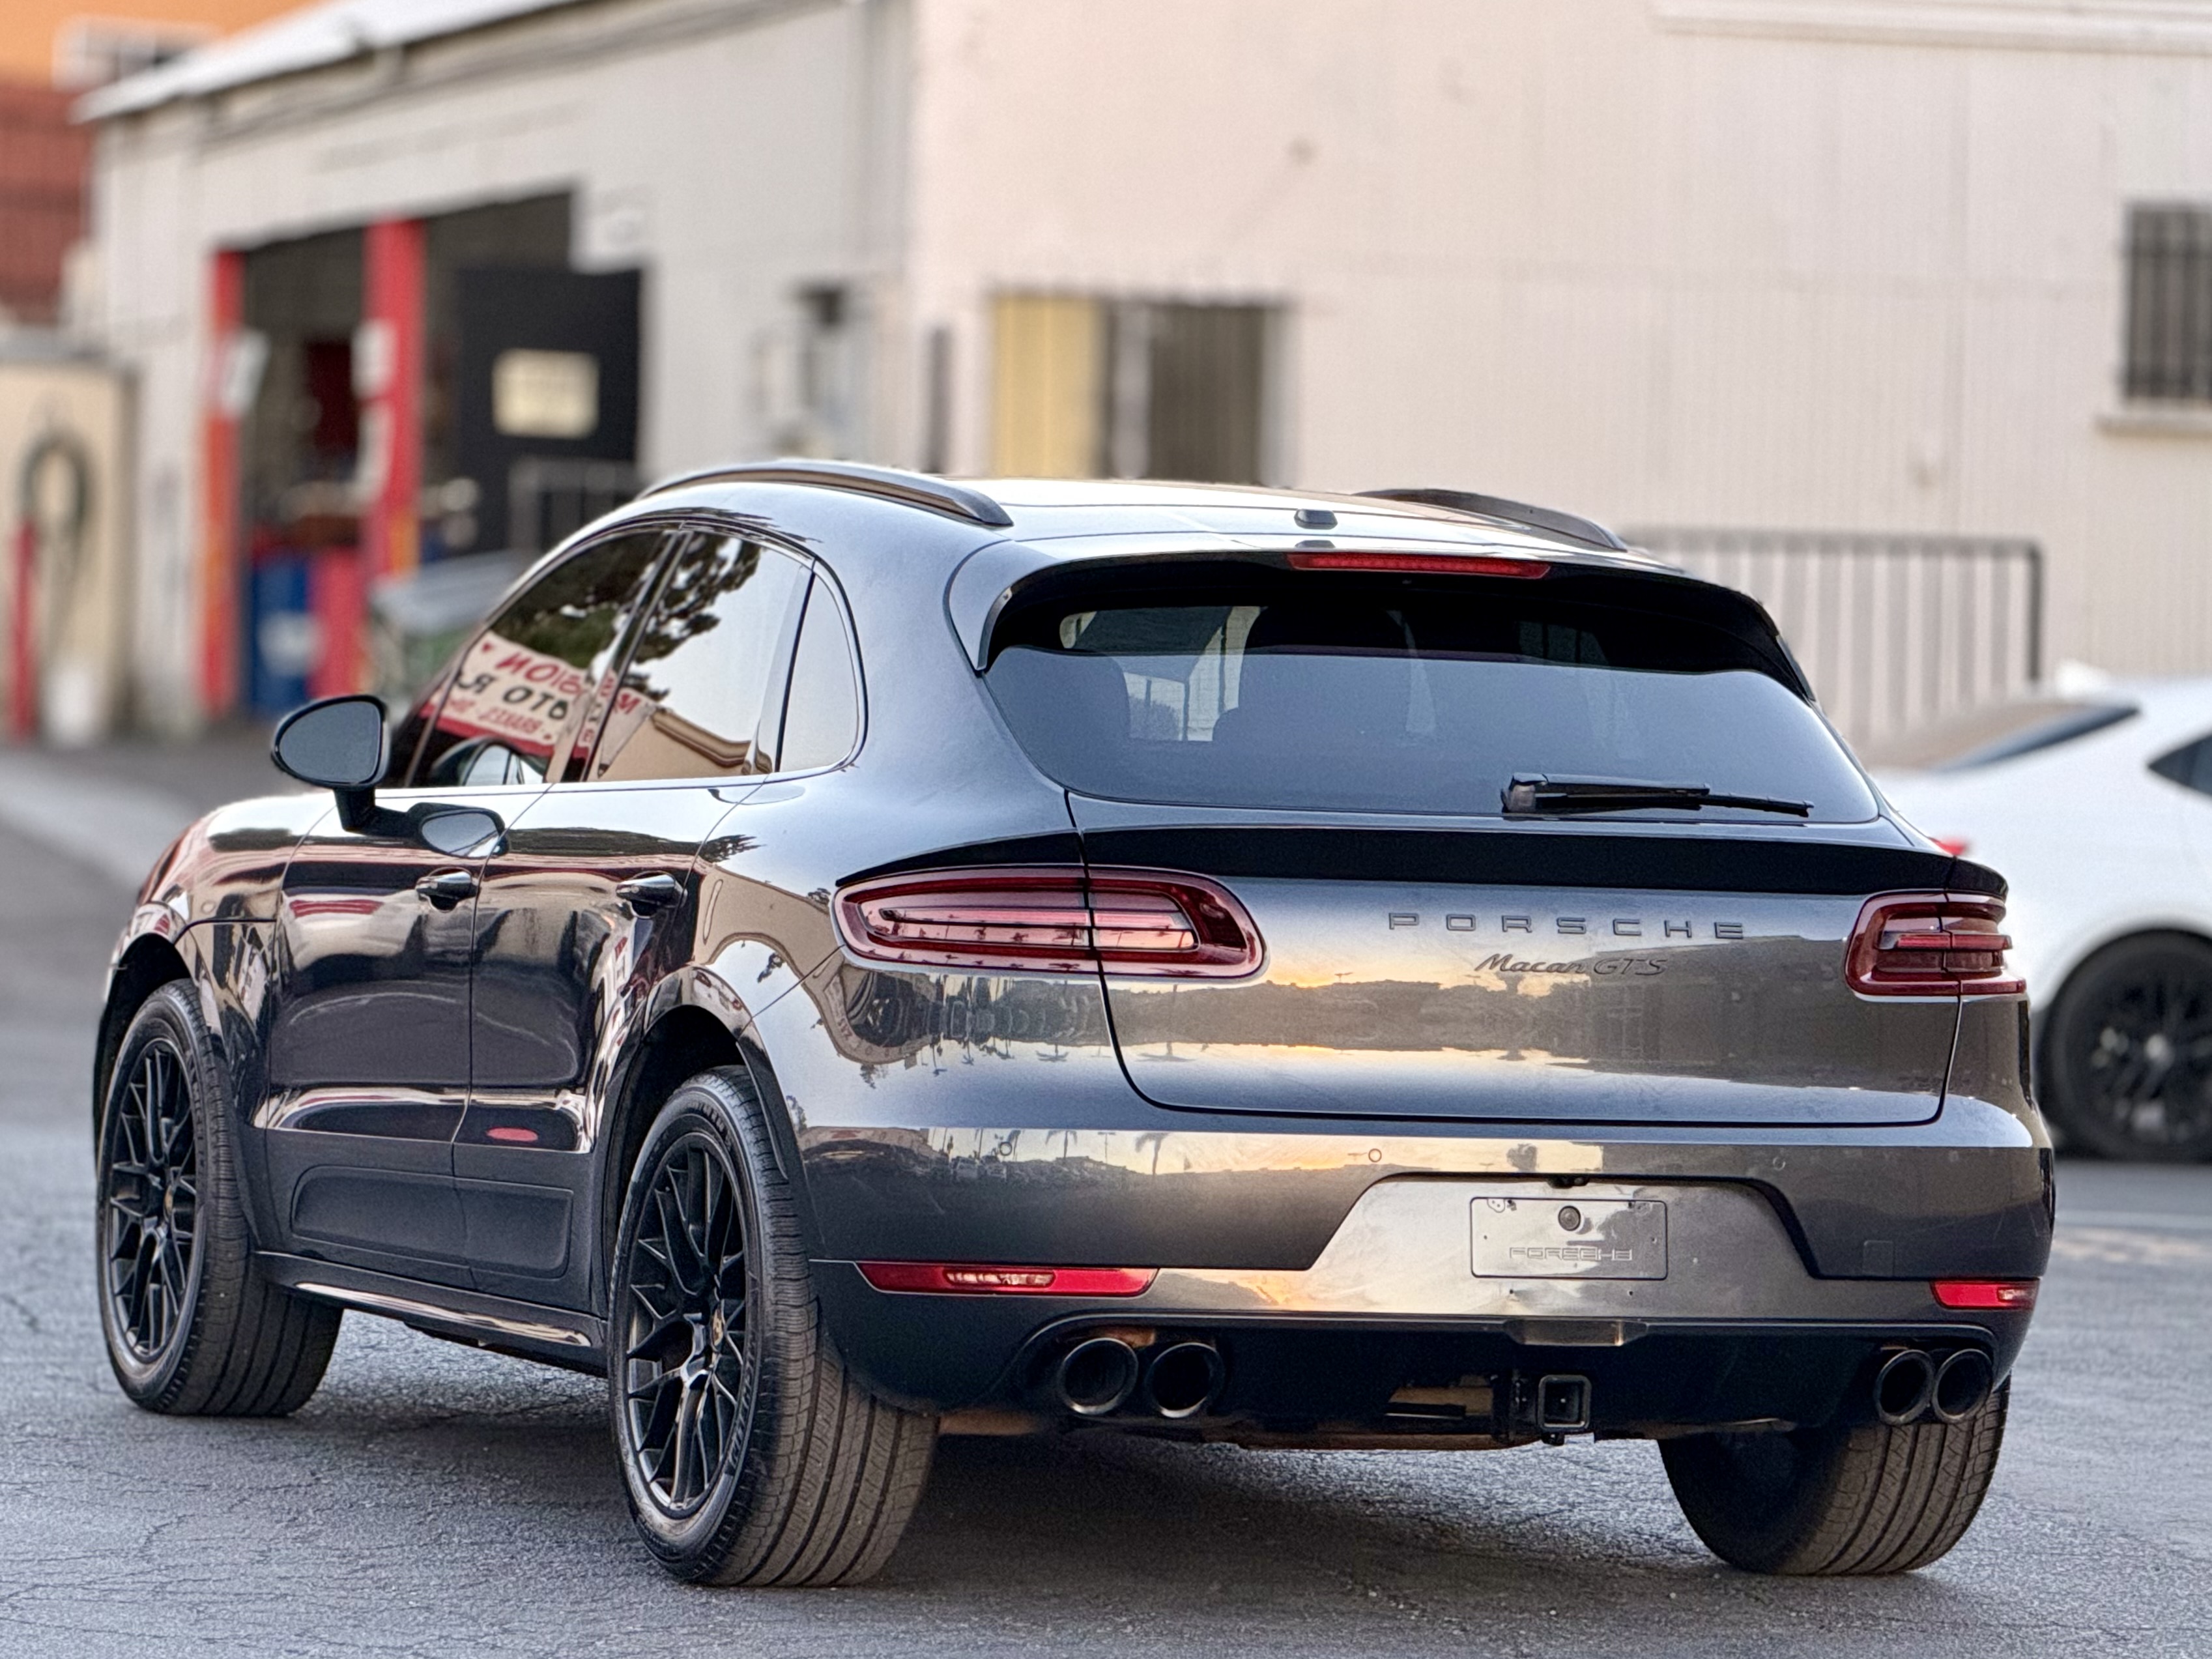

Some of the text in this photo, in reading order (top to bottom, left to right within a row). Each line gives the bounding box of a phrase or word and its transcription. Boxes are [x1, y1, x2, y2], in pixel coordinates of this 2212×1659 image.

[1388, 912, 1744, 940] PORSCHE
[1474, 953, 1668, 976] Macan GTS
